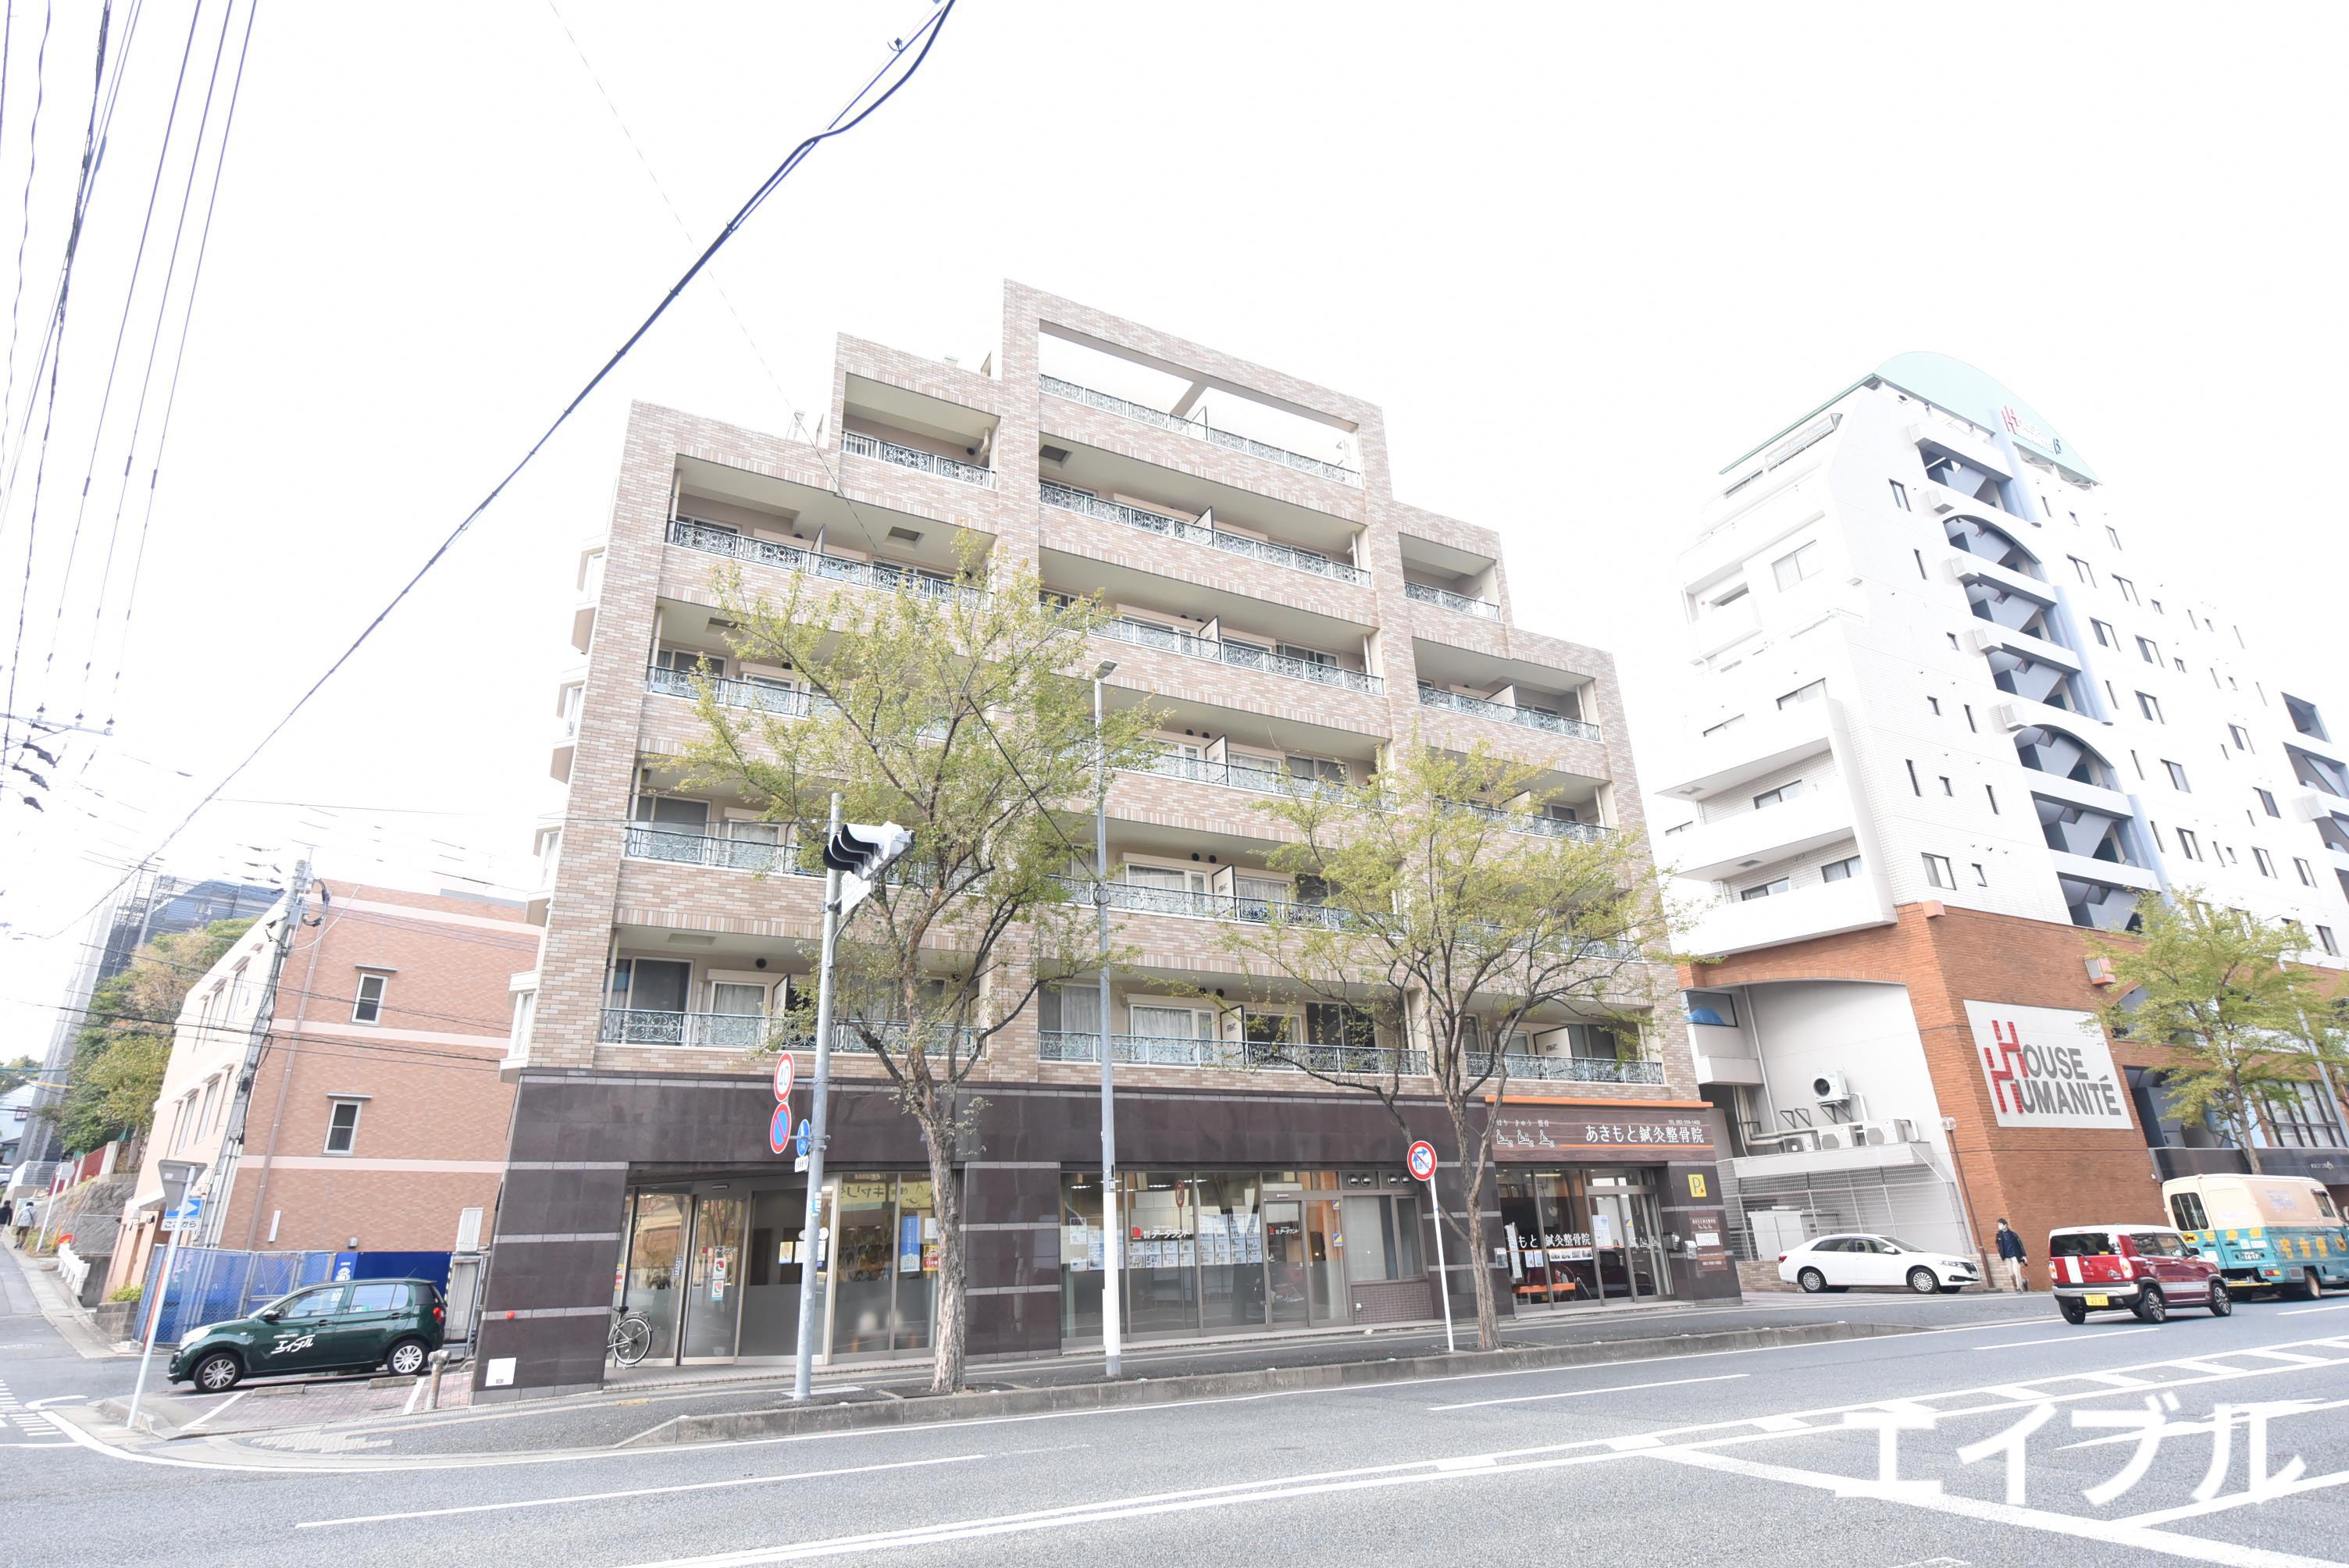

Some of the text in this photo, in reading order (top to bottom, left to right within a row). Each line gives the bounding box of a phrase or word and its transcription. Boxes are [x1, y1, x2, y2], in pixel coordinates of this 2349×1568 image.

[1991, 1020, 2089, 1080] HOUSE
[779, 1066, 790, 1086] 40
[1984, 1047, 2122, 1116] HUMANITÉ
[1585, 1124, 1704, 1143] あきもと鍼灸整骨院
[1692, 1177, 1701, 1194] P
[271, 1334, 315, 1355] エイブル
